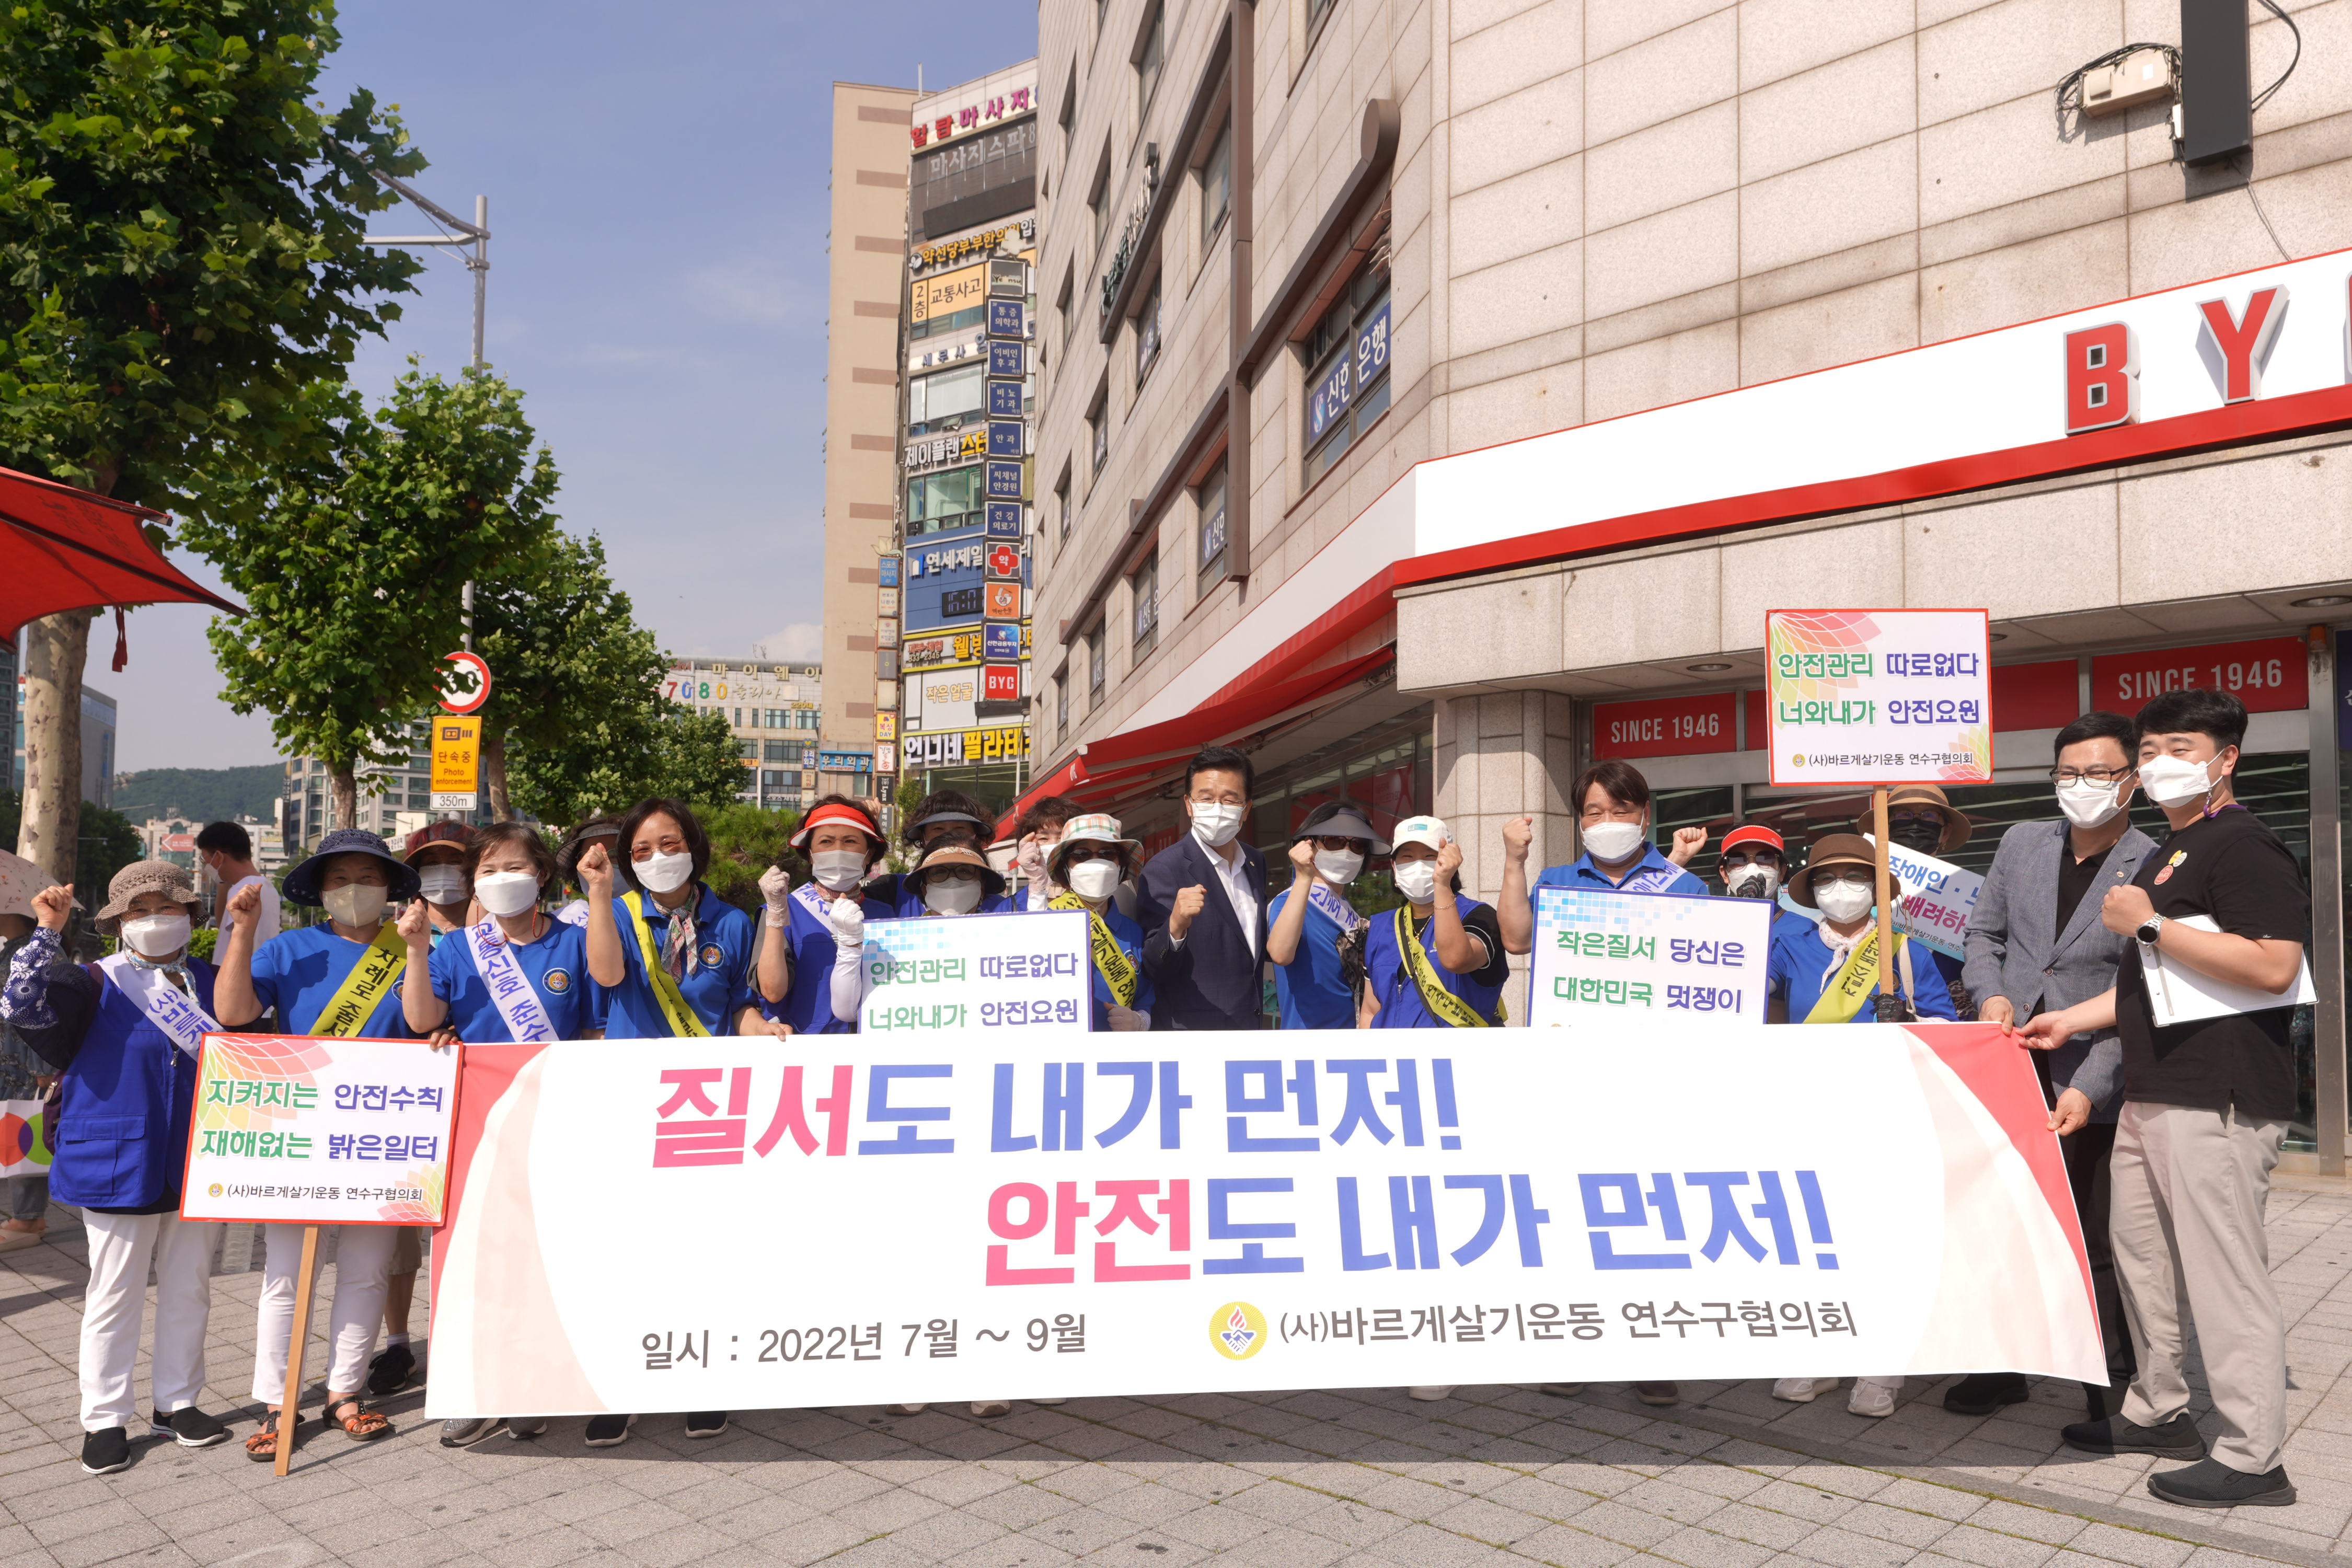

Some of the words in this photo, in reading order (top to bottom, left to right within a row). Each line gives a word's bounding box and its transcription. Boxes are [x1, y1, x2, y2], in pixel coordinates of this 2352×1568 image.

[930, 278, 981, 304] 교통사고
[995, 317, 1019, 328] 의학과
[994, 348, 1018, 358] 이비인
[2063, 269, 2352, 434] BY
[993, 470, 1018, 481] 씨채널
[993, 482, 1017, 492] 안경원
[992, 521, 1017, 532] 의료기
[998, 555, 1009, 566] 약
[1778, 653, 1873, 678] 안전관리
[1886, 652, 1979, 678] 따로없다
[988, 676, 1014, 689] BYC
[2118, 666, 2195, 700] SINCE
[2210, 659, 2282, 691] 1946
[926, 685, 949, 704] 작은
[950, 683, 973, 702] 얼굴
[1780, 700, 1876, 726] 너와내가
[1888, 699, 1980, 724] 안전요원
[1611, 718, 1663, 744] SINCE
[1673, 713, 1719, 739] 1946
[444, 768, 465, 776] Photo
[821, 755, 870, 767] 우리외과
[1808, 754, 1905, 767] (사)바르게살기운동
[1909, 753, 1974, 766] 연수구협의회
[439, 795, 467, 807] 350m
[1889, 855, 1950, 895] 장애인
[1556, 930, 1656, 961] 작은질서
[1670, 938, 1745, 967] 당신은
[350, 948, 400, 1001] 차례로
[870, 958, 966, 985] 안전관리
[979, 952, 1078, 979] 따로없다
[1553, 976, 1653, 1007] 대한민국
[1666, 985, 1742, 1013] 멋쟁이
[869, 1003, 967, 1031] 너와내가
[980, 998, 1078, 1026] 안전요원
[206, 1080, 319, 1109] 지켜지는
[333, 1084, 443, 1112] 안전수칙
[652, 1064, 955, 1168] 질서도
[990, 1060, 1193, 1152] 내가
[1224, 1058, 1462, 1153] 먼저!
[200, 1129, 313, 1159] 재해없는
[328, 1133, 438, 1162] 밝은일터
[227, 1183, 341, 1200] (사)바르게살기운동
[346, 1187, 423, 1201] 연수구협의회
[985, 1177, 1304, 1286] 안전도
[1336, 1175, 1551, 1271] 내가
[1577, 1170, 1840, 1271] 먼저!
[1279, 1302, 1605, 1346] (사)바르게살기운동
[1620, 1300, 1858, 1337] 연수구협의회
[641, 1329, 709, 1370] 일시
[758, 1322, 883, 1362] 2022년
[900, 1318, 959, 1358] 7월
[1025, 1313, 1087, 1353] 9월
